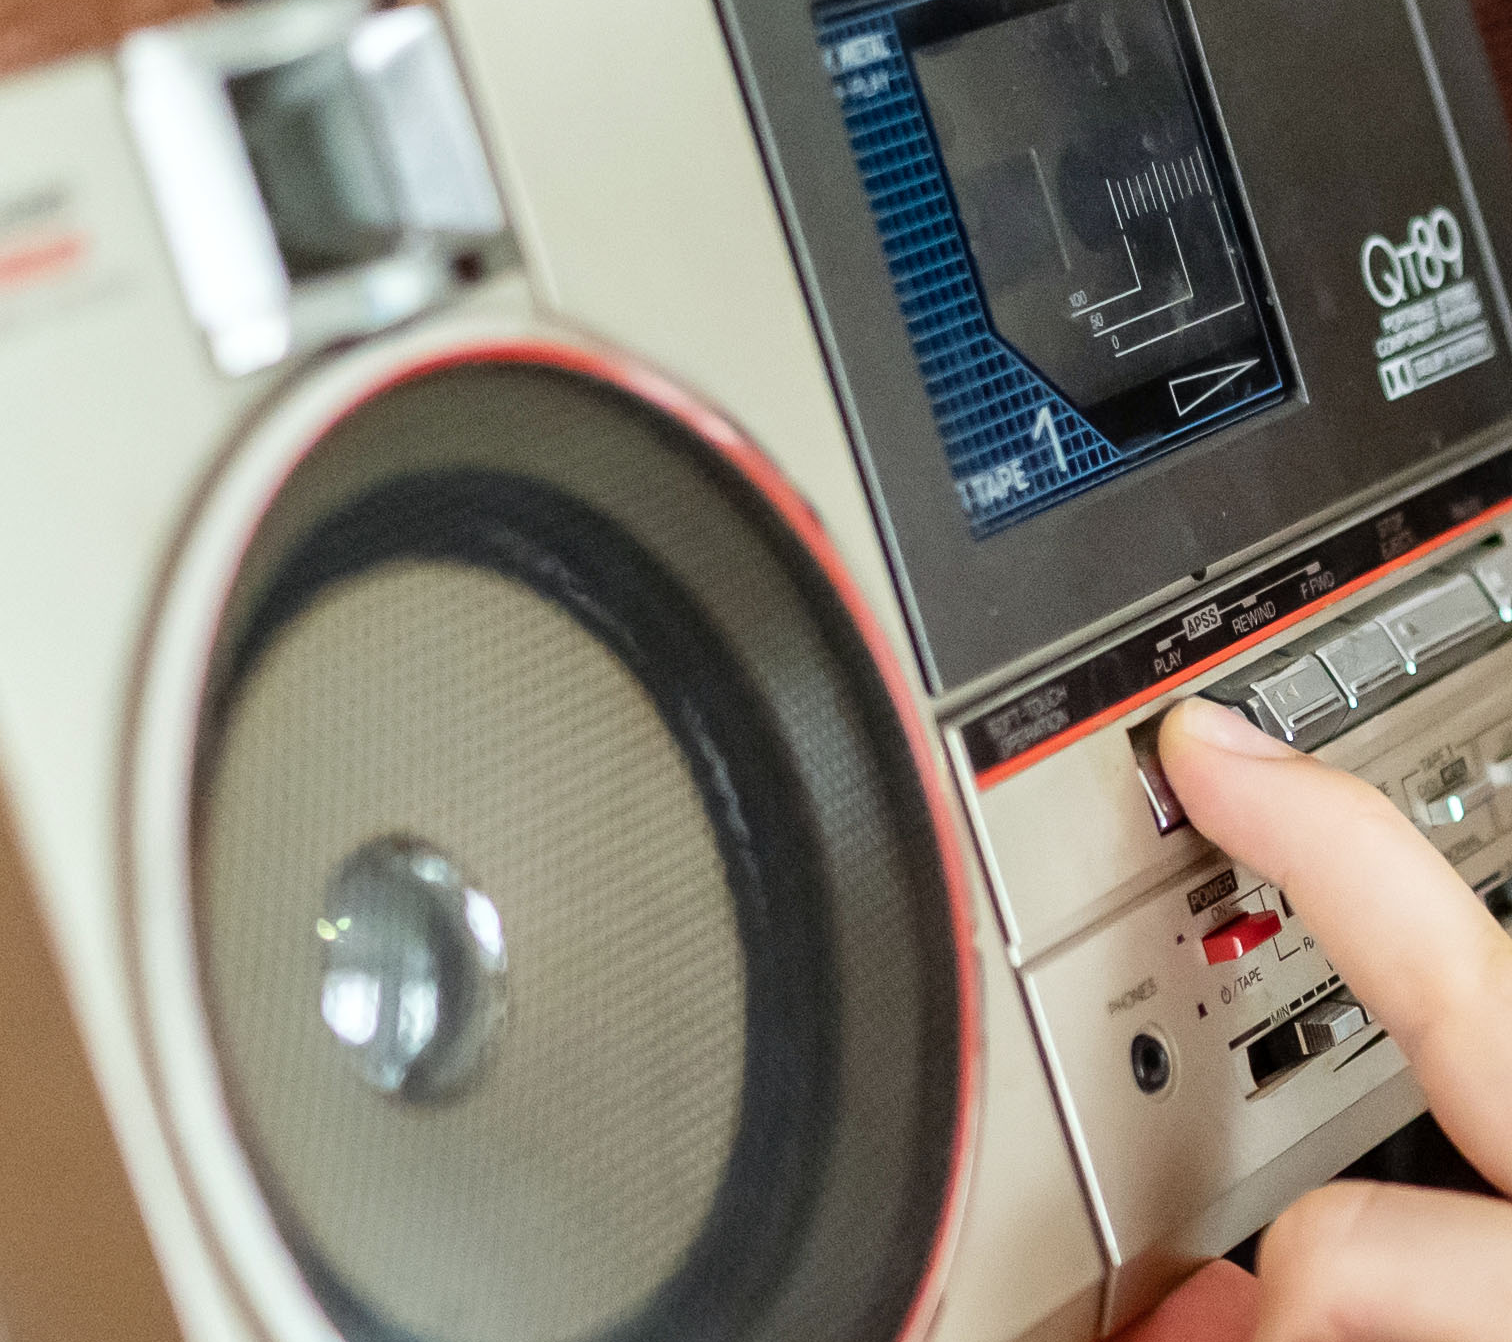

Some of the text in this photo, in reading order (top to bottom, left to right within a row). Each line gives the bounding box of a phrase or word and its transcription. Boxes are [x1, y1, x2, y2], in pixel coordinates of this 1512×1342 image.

[1361, 207, 1464, 307] QT89
[1069, 290, 1087, 307] 100
[1090, 312, 1104, 330] 50
[1112, 335, 1120, 349] 0
[968, 406, 1067, 508] TAPE 1
[1187, 609, 1219, 636] APSS
[1232, 601, 1276, 635] REWIND
[1154, 649, 1183, 676] PLAY
[1190, 874, 1236, 910] POWER
[1271, 1003, 1290, 1024] MIN
